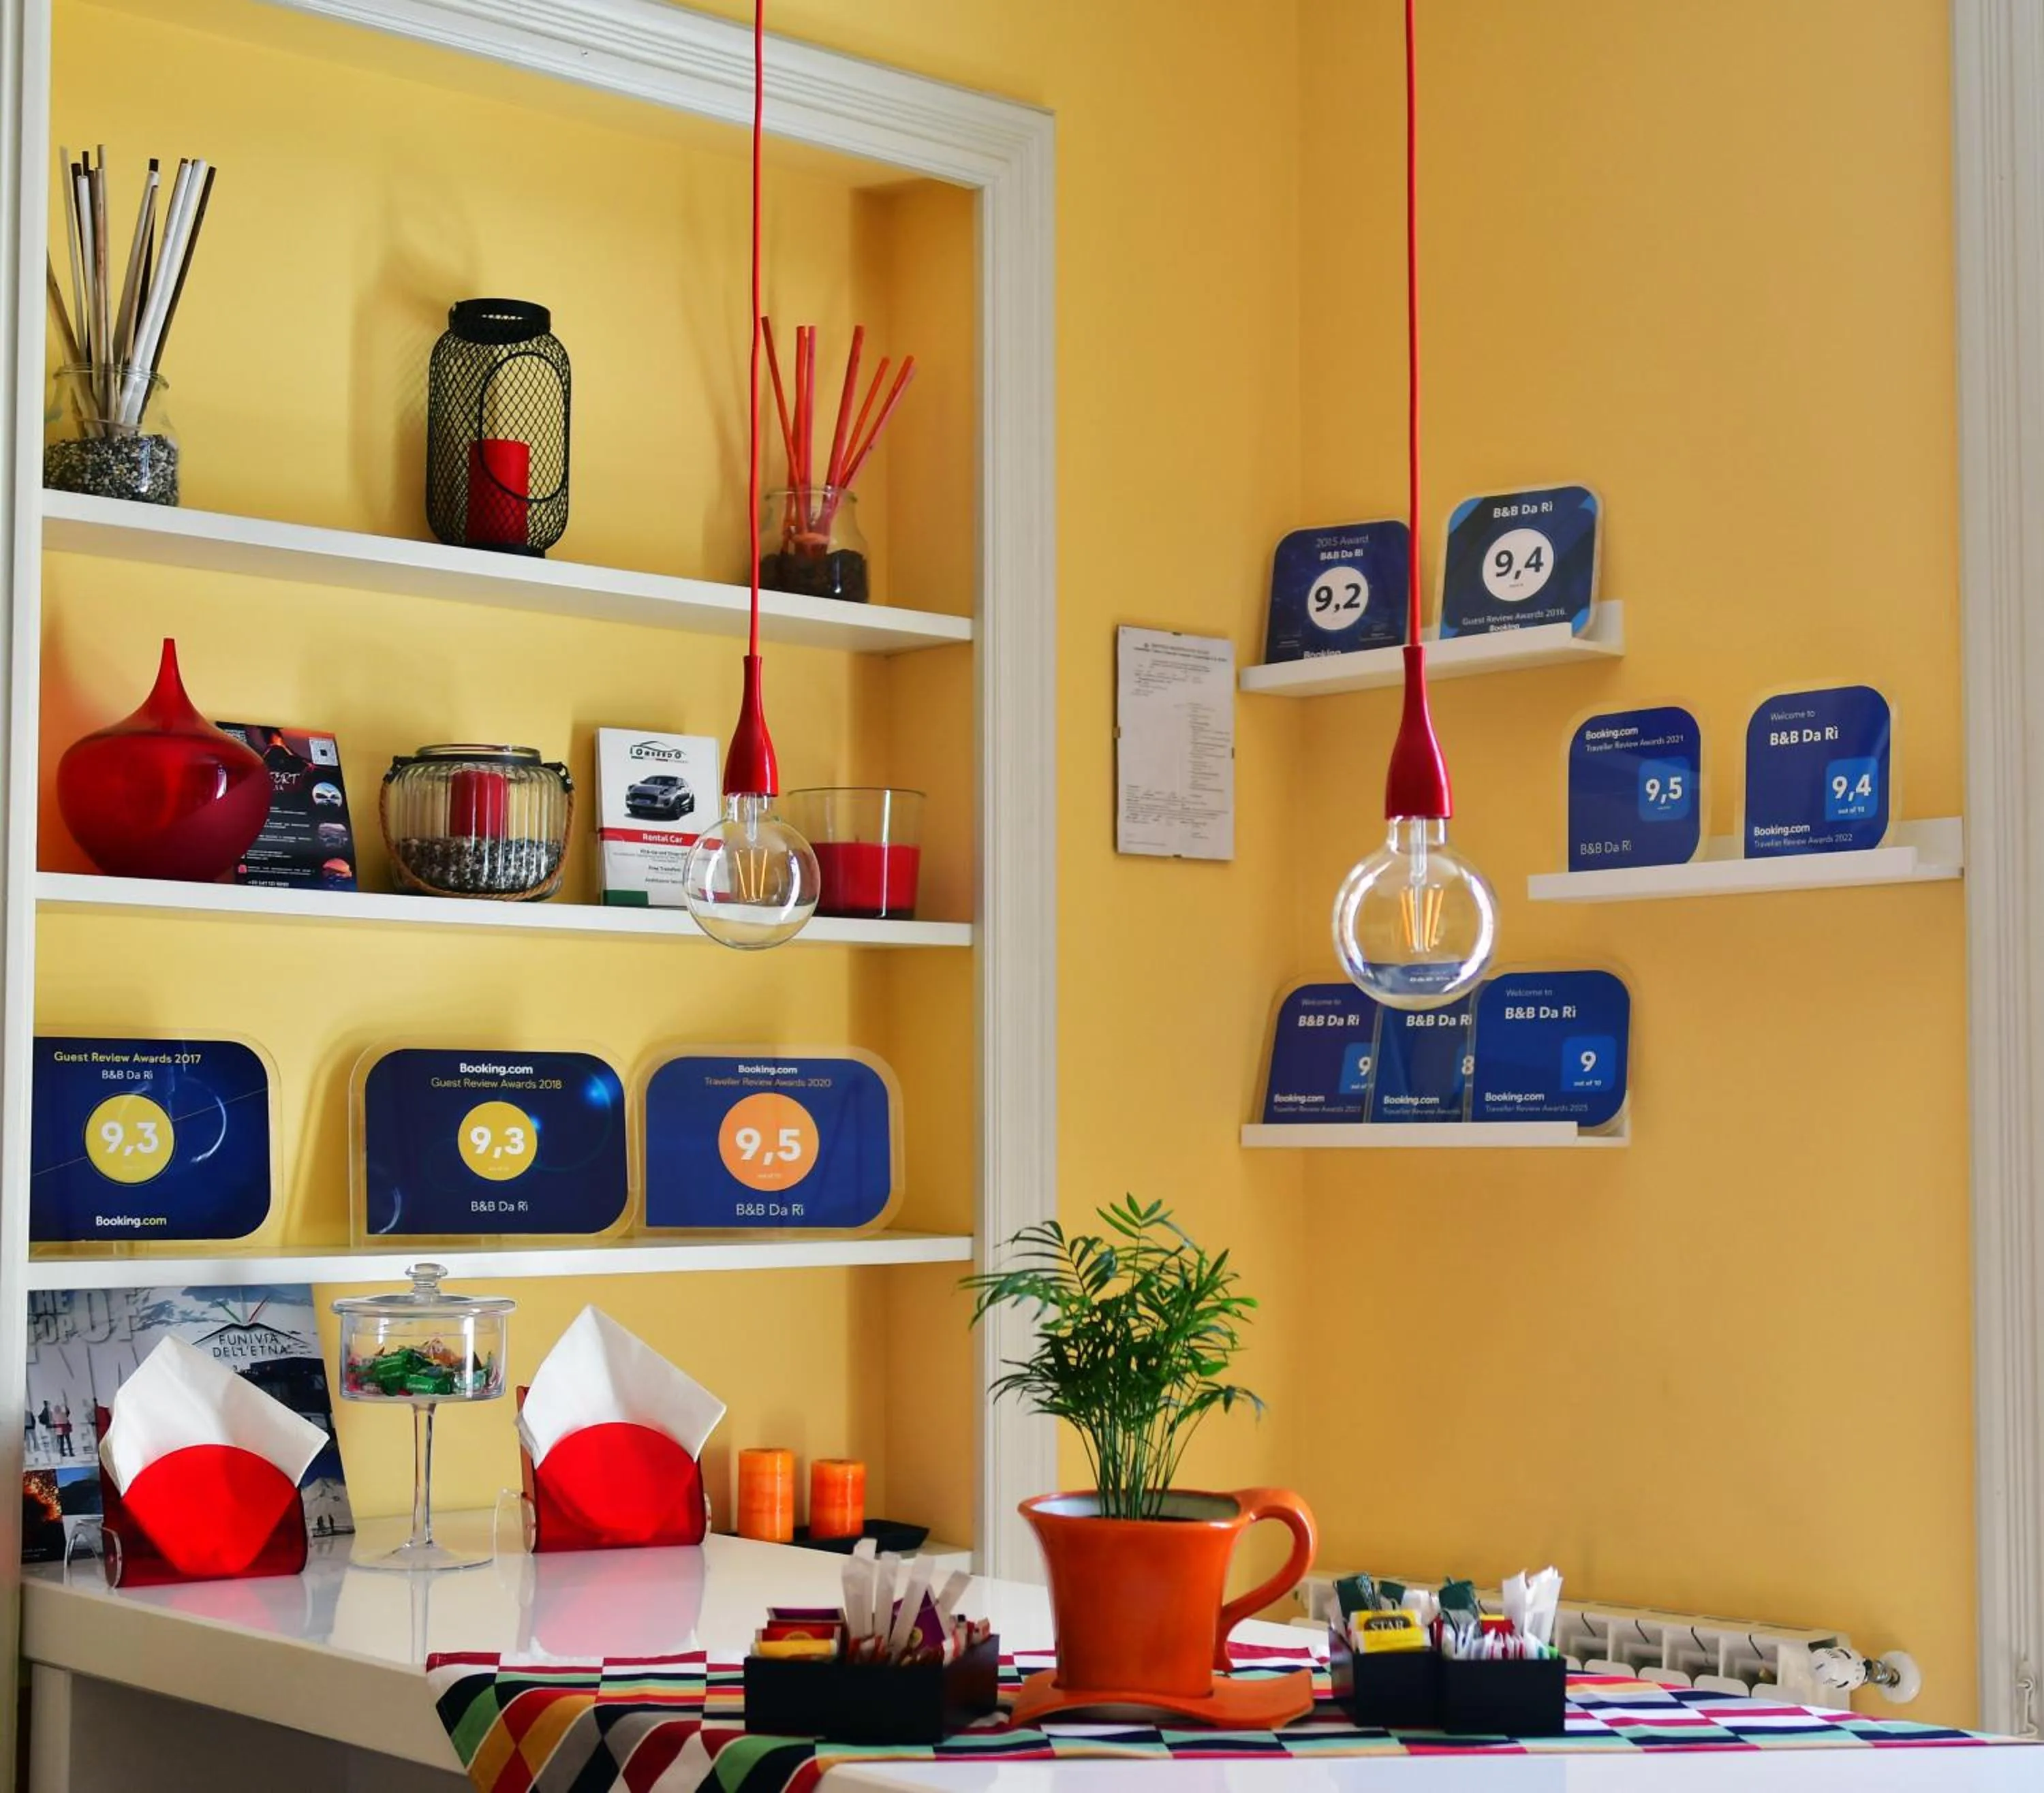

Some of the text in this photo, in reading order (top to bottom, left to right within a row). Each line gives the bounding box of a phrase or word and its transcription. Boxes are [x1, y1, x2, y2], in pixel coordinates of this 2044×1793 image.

[1493, 506, 1518, 518] B&B
[1521, 504, 1538, 514] Da
[1320, 551, 1339, 561] B&B
[1341, 550, 1353, 559] Da
[1496, 546, 1544, 579] 9,4
[1315, 583, 1361, 612] 9,2
[1462, 608, 1565, 625] Guest Review Awards 2016
[1771, 711, 1805, 721] Welcome
[1585, 727, 1639, 740] Booking.com
[1770, 731, 1799, 746] B&B
[1802, 730, 1821, 743] Da
[1615, 740, 1639, 749] Review
[1640, 738, 1664, 747] Awards
[1666, 734, 1684, 744] 2021
[1645, 777, 1682, 804] 9,5
[1832, 774, 1872, 801] 9,4
[1754, 824, 1810, 837] Booking.com
[642, 833, 683, 843] Rental Car
[1834, 833, 1853, 843] 2022
[1580, 843, 1602, 855] B&B
[1605, 841, 1619, 854] Da
[1506, 988, 1553, 997] Welcome to
[1505, 1006, 1535, 1020] B&B
[1539, 1007, 1558, 1018] Da
[1298, 1015, 1325, 1027] B&B
[1327, 1014, 1344, 1027] Da
[1406, 1014, 1435, 1027] B&B
[1438, 1014, 1456, 1027] Da
[54, 1051, 201, 1064] Guest Review Awards 2017
[1581, 1051, 1596, 1072] 9
[102, 1070, 124, 1079] B&B
[127, 1070, 141, 1080] Da
[459, 1063, 533, 1076] Booking.com
[738, 1065, 798, 1076] Booking.com
[431, 1077, 562, 1089] Guest Review Awards 2018
[743, 1077, 773, 1087] Review
[774, 1078, 805, 1088] Awards
[807, 1078, 832, 1088] 2020
[1274, 1093, 1325, 1104] Booking.com
[1384, 1095, 1440, 1106] Booking.com
[1485, 1092, 1545, 1103] Booking.com
[102, 1121, 159, 1157] 9,3
[471, 1126, 525, 1159] 9,3
[736, 1127, 801, 1166] 9,5
[470, 1201, 495, 1211] B&B
[498, 1201, 514, 1211] Da
[736, 1203, 764, 1216] B&B
[769, 1204, 788, 1216] Da
[96, 1215, 167, 1228] Booking.com
[219, 1332, 279, 1345] FUNIVIA
[213, 1345, 287, 1358] DELL'ETNA
[1371, 1619, 1405, 1631] STAR
